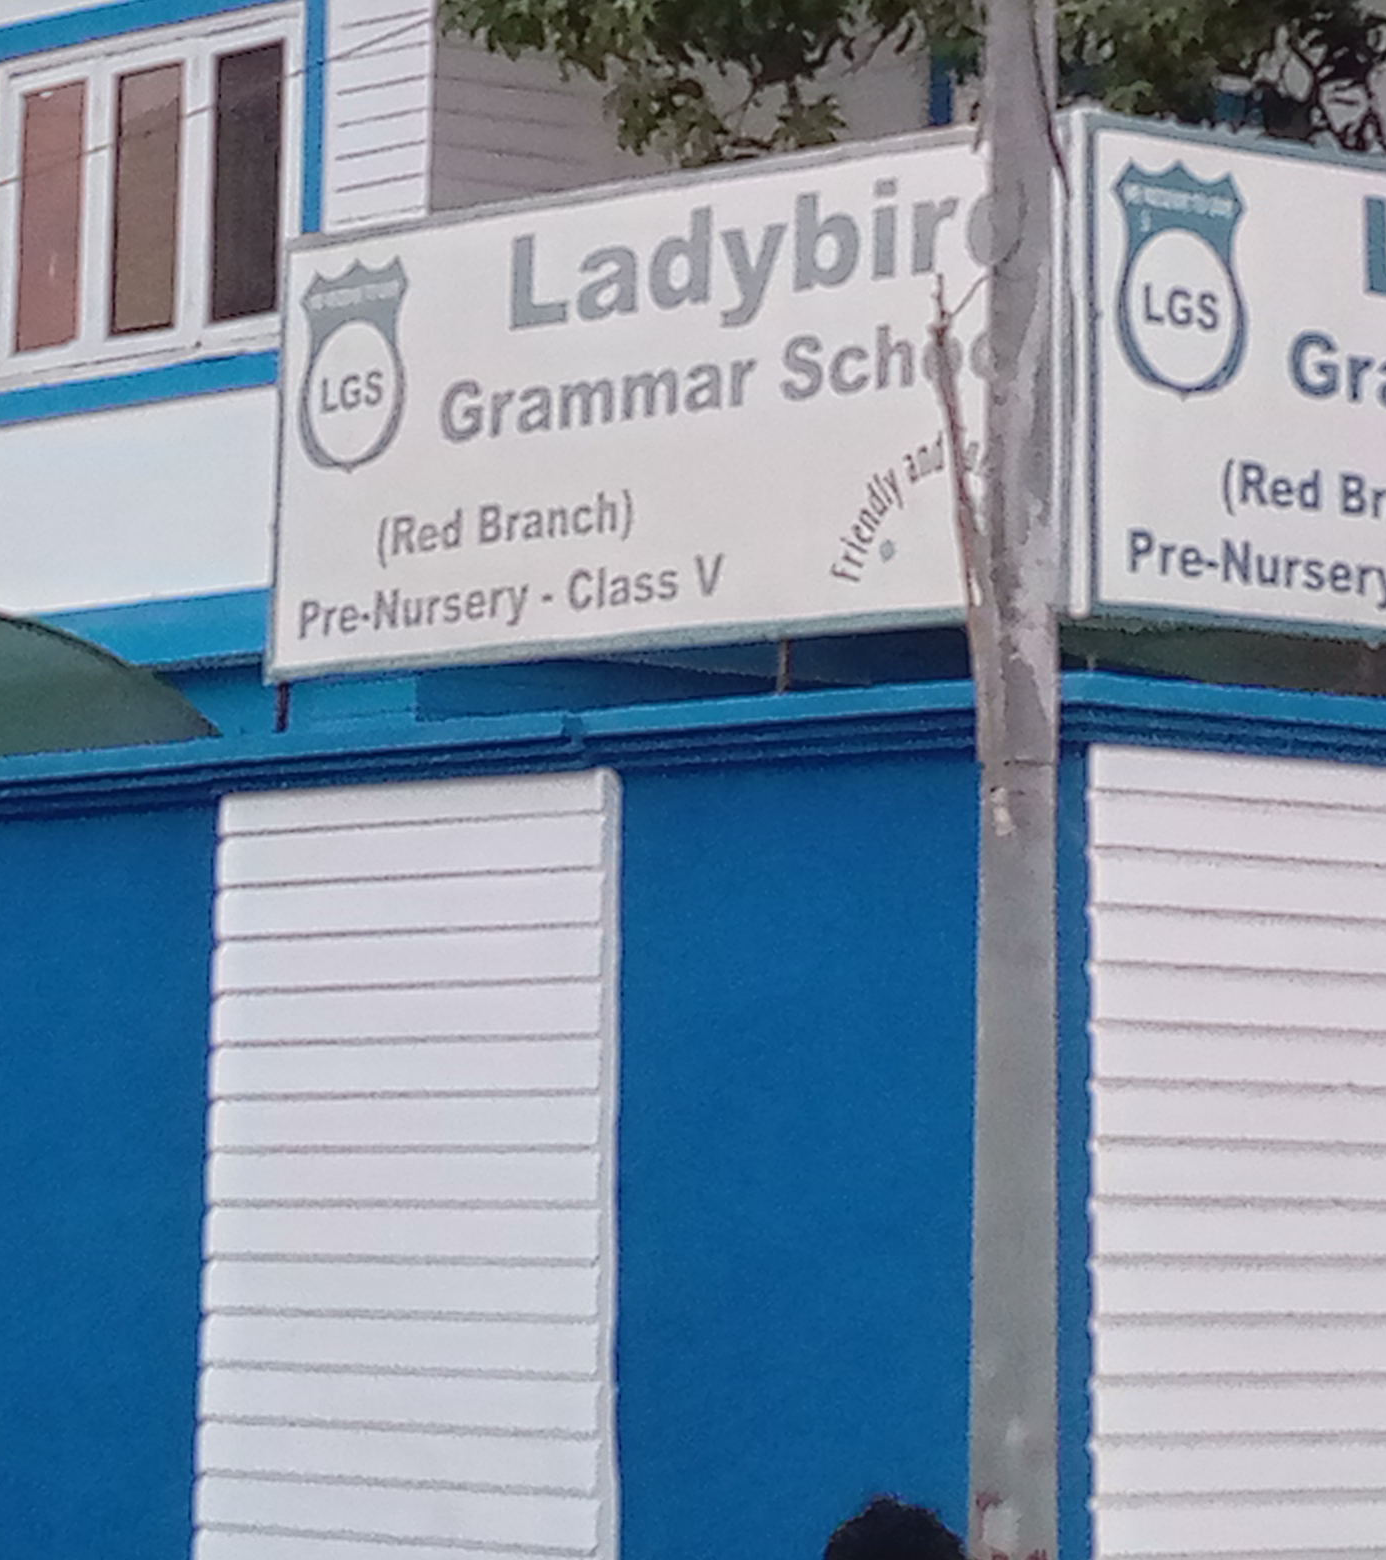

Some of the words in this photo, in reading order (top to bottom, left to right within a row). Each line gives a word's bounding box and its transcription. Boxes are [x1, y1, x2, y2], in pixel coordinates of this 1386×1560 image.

[510, 179, 991, 330] Ladybir
[1144, 283, 1217, 329] LGS
[320, 370, 384, 414] LGS
[439, 358, 756, 443] Grammar
[1222, 459, 1321, 514] (Red
[376, 509, 462, 568] (Red
[478, 489, 634, 542] Branch)
[300, 586, 528, 639] Pre-Nursery
[568, 569, 678, 612] Class
[694, 553, 725, 598] V
